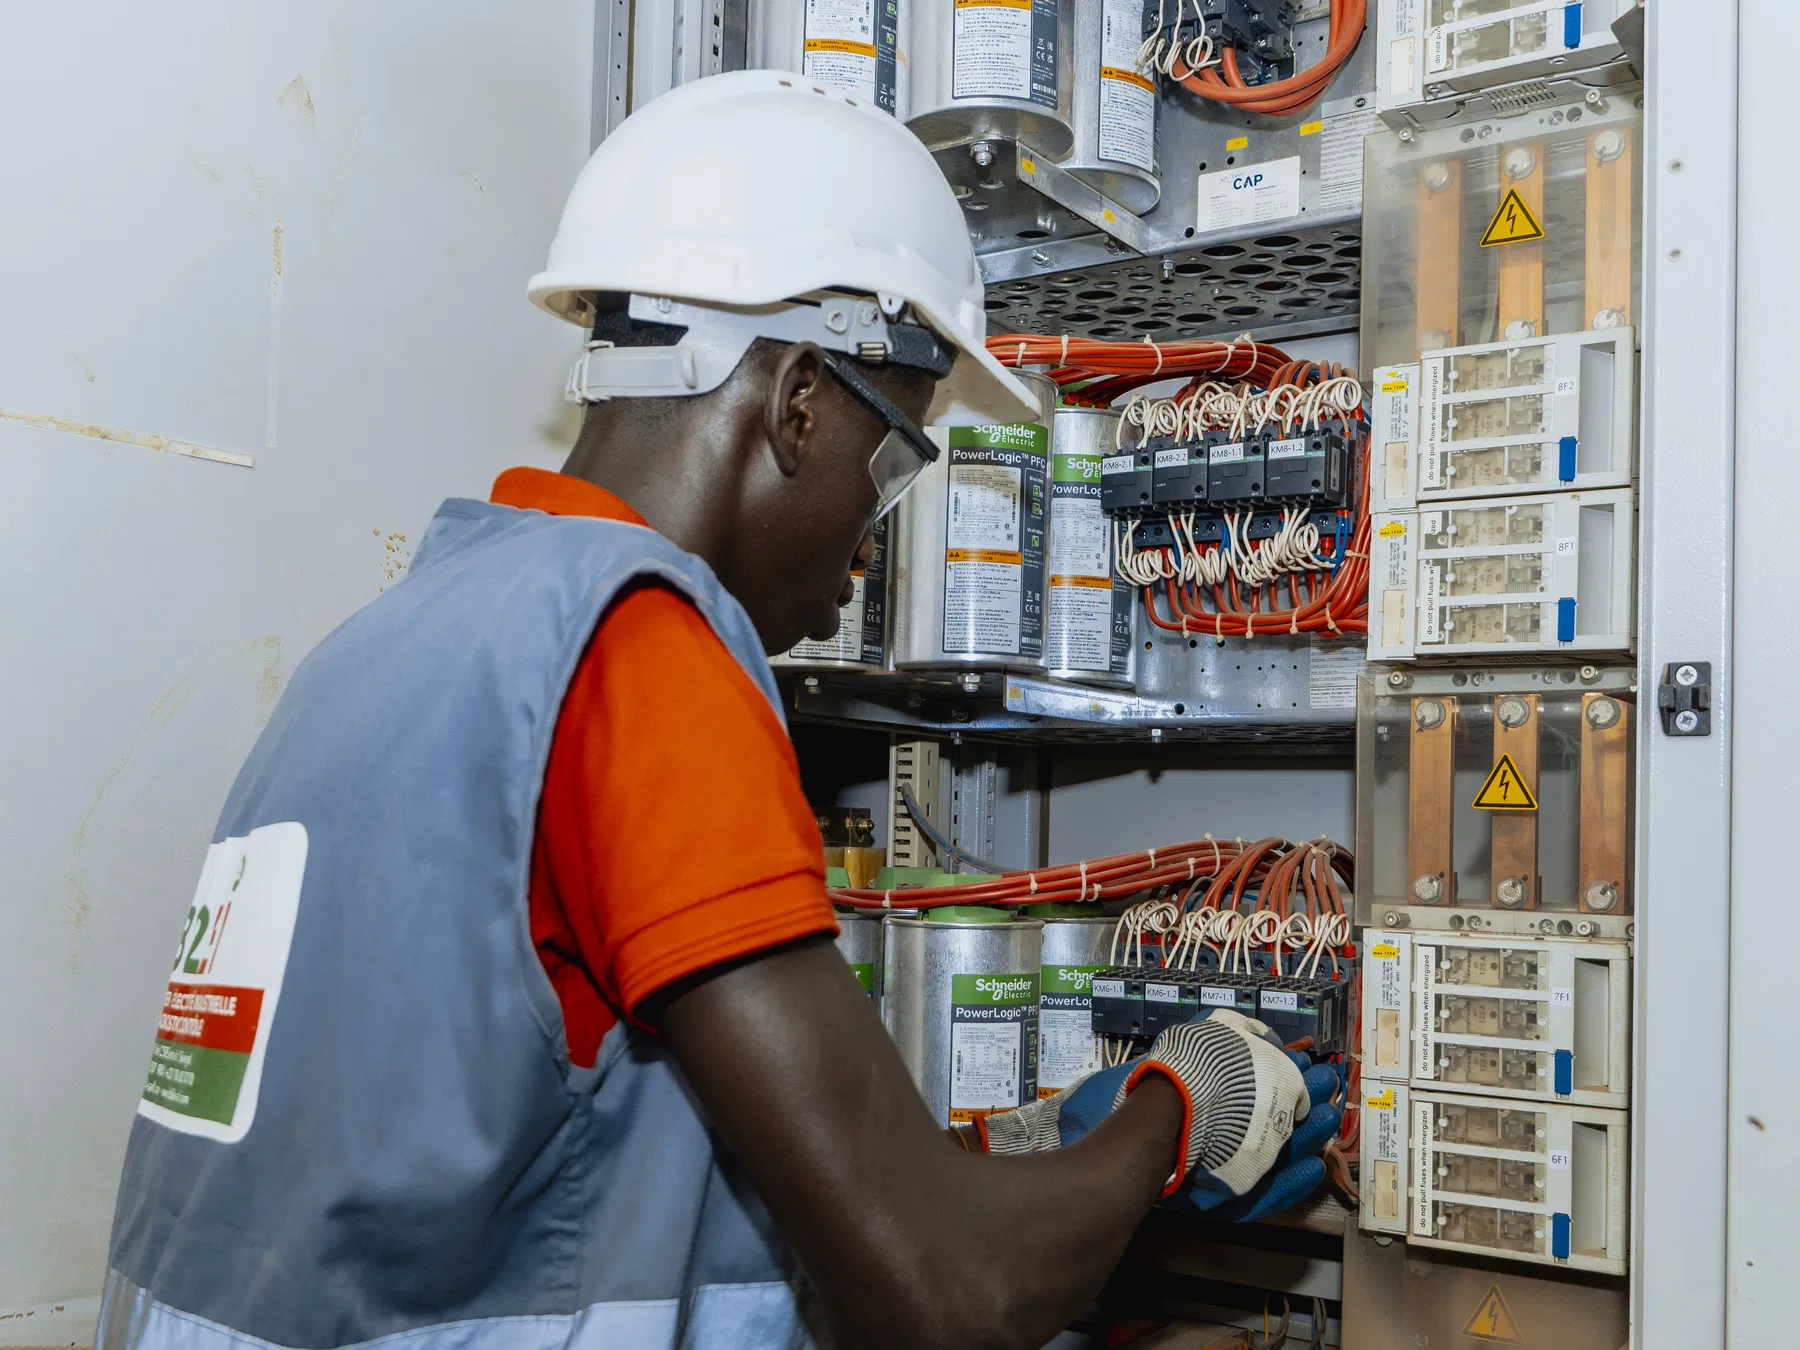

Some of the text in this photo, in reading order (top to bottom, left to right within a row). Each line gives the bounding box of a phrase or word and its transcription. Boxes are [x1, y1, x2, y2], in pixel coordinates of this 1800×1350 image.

[1434, 54, 1441, 64] do
[1233, 174, 1264, 190] CAP
[1432, 366, 1440, 400] energized
[1557, 381, 1574, 391] 8F2
[973, 424, 1035, 439] Schneider
[1002, 435, 1034, 447] Electric
[1212, 448, 1242, 458] KM8-1.1
[1271, 443, 1303, 454] KM8-1.2
[1428, 443, 1437, 456] pull
[1030, 456, 1046, 468] PFC
[1067, 458, 1102, 470] Schne
[1156, 453, 1186, 464] KM8-2.2
[1104, 460, 1132, 470] KM8-2.1
[1428, 471, 1435, 480] do
[1559, 543, 1574, 551] 8F1
[1427, 626, 1434, 635] do
[1058, 969, 1094, 981] Schne
[975, 978, 1032, 992] Schneider
[1094, 985, 1123, 993] KM6-1.1
[1004, 990, 1031, 999] Electric
[1147, 990, 1177, 998] KM6-1.2
[1202, 991, 1233, 1001] KM7-1.1
[1554, 993, 1569, 1001] 7F1
[1040, 995, 1092, 1008] PowerLog
[1262, 995, 1295, 1006] KM7-1.2
[1027, 1005, 1039, 1016] PFC
[1422, 1033, 1430, 1047] pull
[1422, 1062, 1428, 1072] do
[1421, 1110, 1429, 1146] energized
[1551, 1155, 1567, 1164] 6F1
[1420, 1189, 1428, 1204] pull
[1420, 1218, 1426, 1228] do
